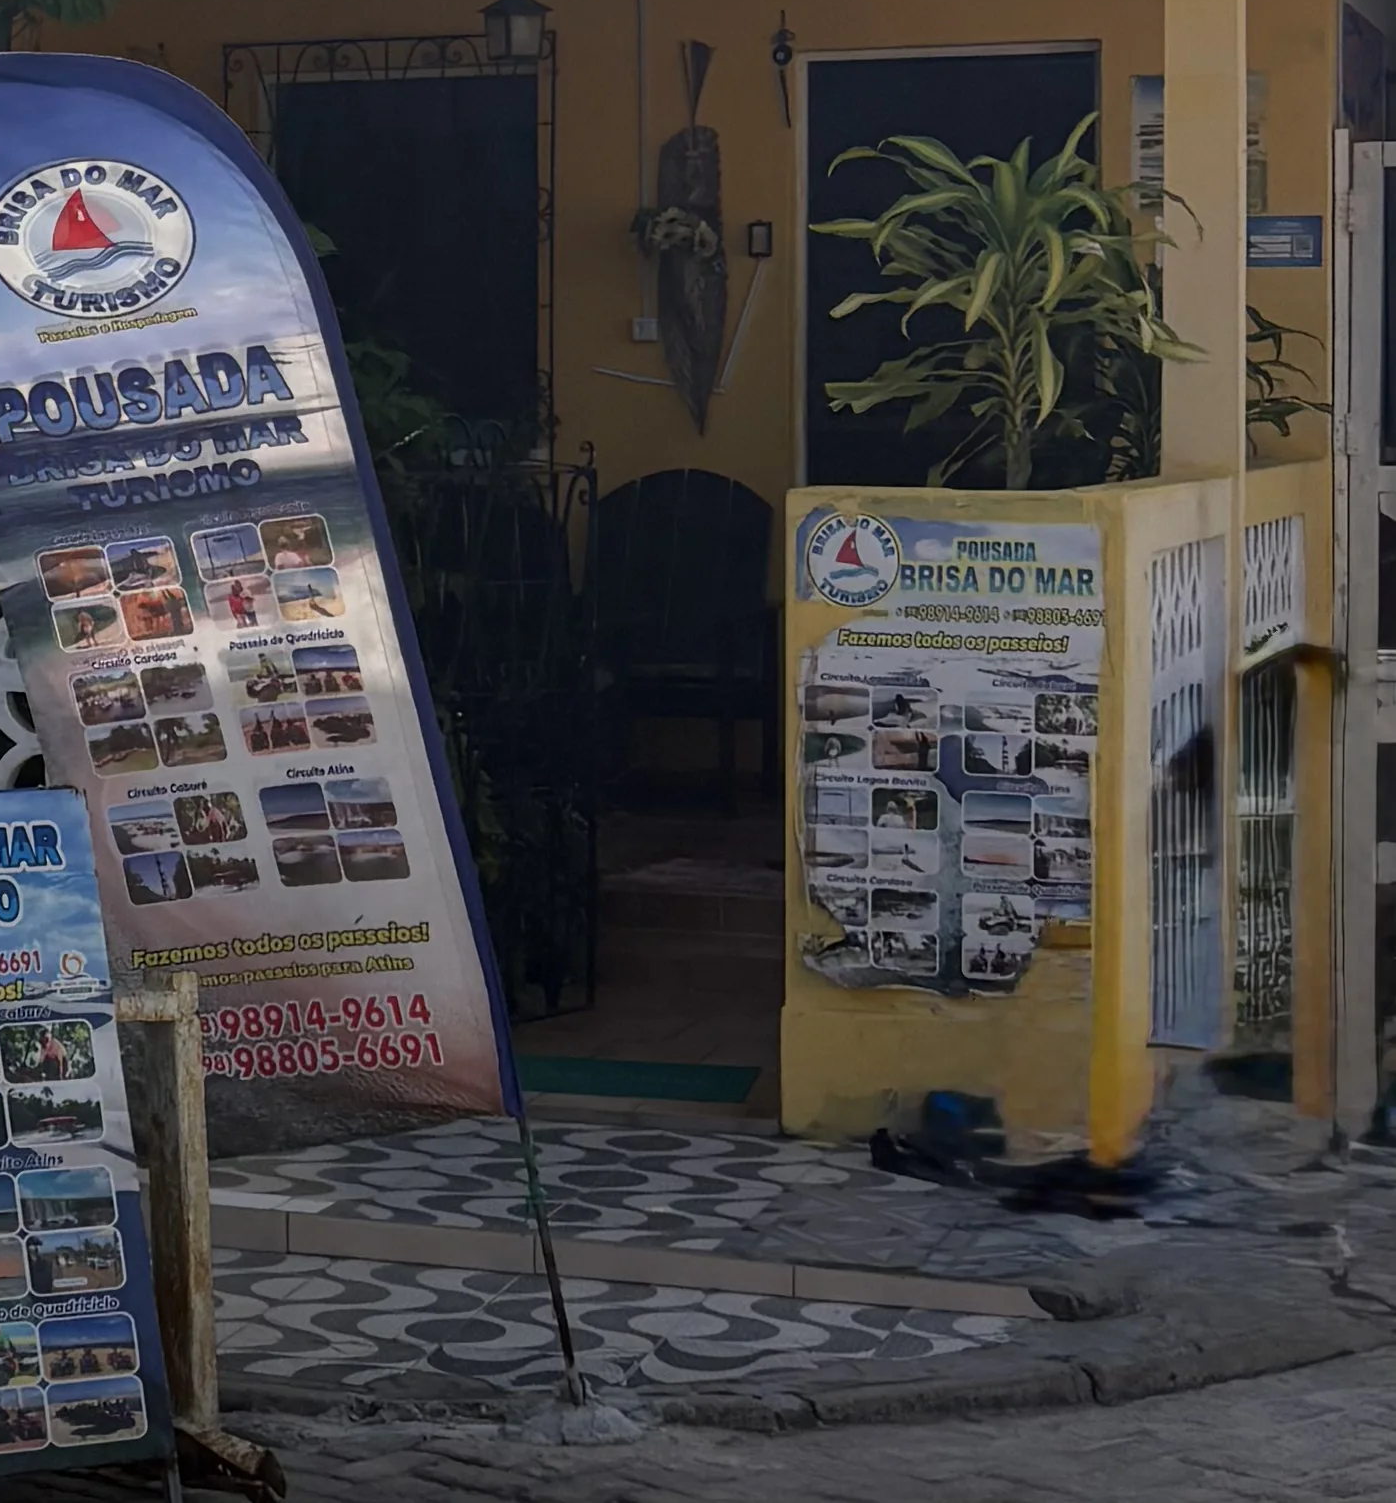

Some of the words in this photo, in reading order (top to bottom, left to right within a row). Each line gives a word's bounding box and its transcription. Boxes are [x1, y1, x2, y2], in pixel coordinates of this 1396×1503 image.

[60, 165, 106, 188] DO
[116, 169, 178, 220] MAR
[29, 257, 181, 312] TURISMO
[9, 449, 134, 486] BRISA
[144, 437, 202, 467] DO
[211, 415, 309, 455] MAR
[67, 458, 261, 510] TURISMO
[957, 541, 1037, 563] POUSADA
[900, 564, 980, 594] BRISA
[989, 566, 1026, 594] DO
[1035, 568, 1095, 597] MAR
[837, 629, 911, 648] Fazemos
[913, 631, 961, 649] todos
[964, 635, 985, 650] os
[986, 632, 1070, 654] passeios!
[132, 940, 228, 969] Fazemos
[232, 933, 295, 957] todos
[299, 930, 323, 949] os
[327, 921, 429, 952] passeios!
[321, 959, 362, 977] para
[365, 955, 413, 973] Atins
[201, 994, 431, 1041] 8)98914-9614
[203, 1033, 443, 1080] 98)98805-6691
[27, 1152, 64, 1169] Atins
[10, 1304, 29, 1319] de
[32, 1296, 120, 1317] Quadriciclo
